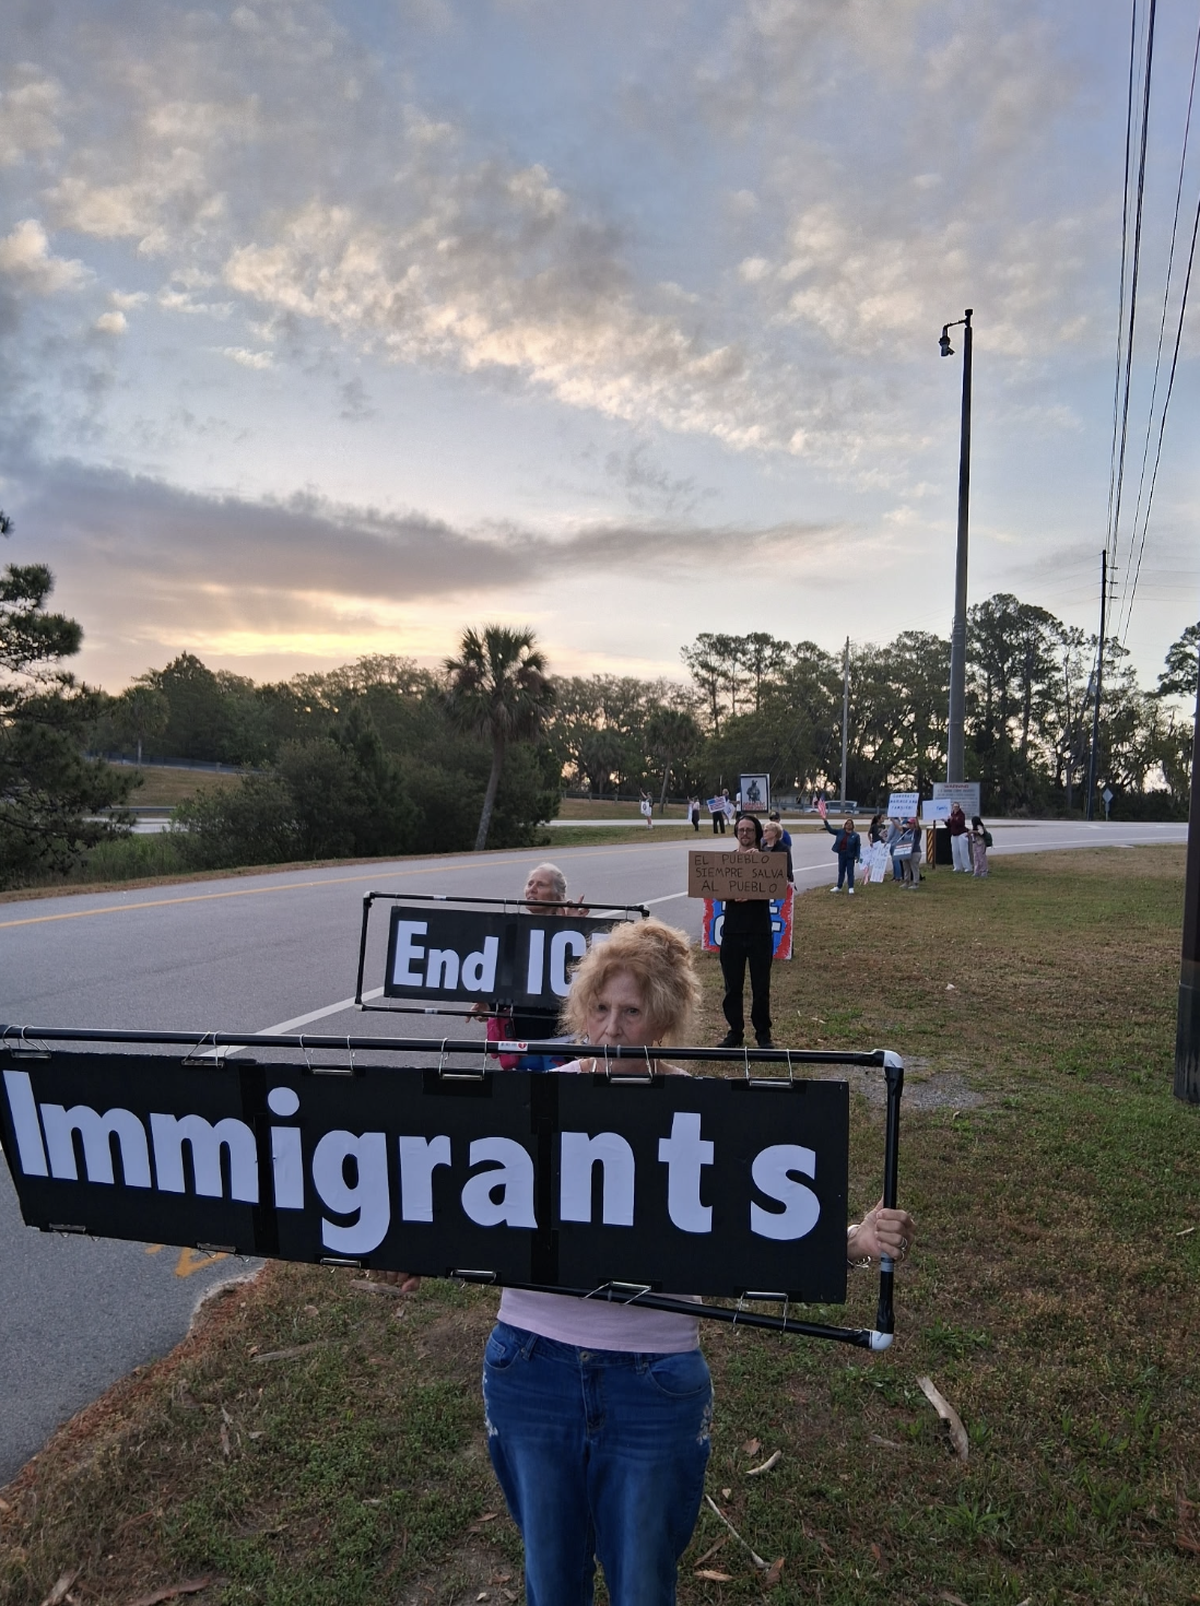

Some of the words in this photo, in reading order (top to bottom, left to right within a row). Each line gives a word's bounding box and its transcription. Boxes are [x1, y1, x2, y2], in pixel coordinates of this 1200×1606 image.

[694, 855, 709, 865] EL
[722, 853, 770, 864] PUEBLO
[695, 867, 743, 878] SIEMPRE
[752, 868, 784, 878] SALVA
[701, 880, 719, 892] AL
[729, 881, 778, 893] PUEBLO
[393, 920, 499, 993] End
[527, 929, 611, 997] IC
[3, 1070, 821, 1254] Immigrants
